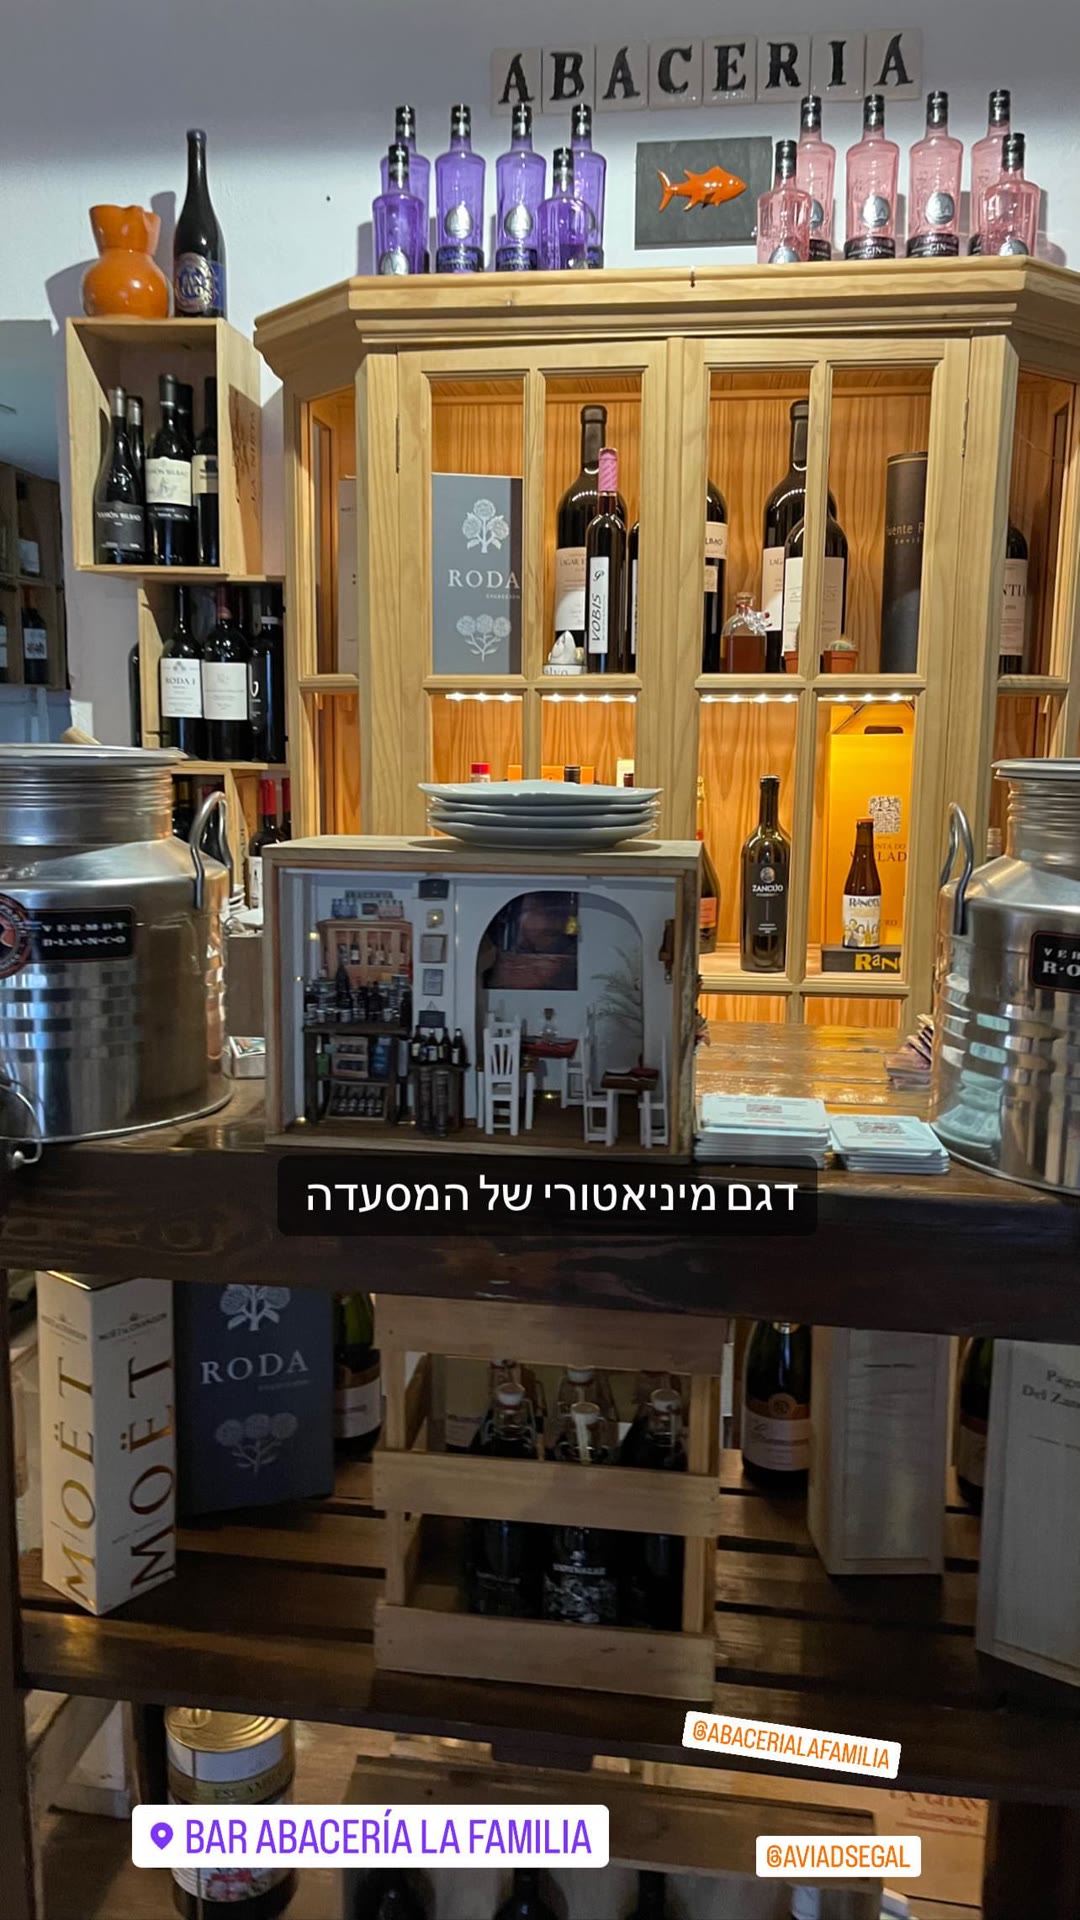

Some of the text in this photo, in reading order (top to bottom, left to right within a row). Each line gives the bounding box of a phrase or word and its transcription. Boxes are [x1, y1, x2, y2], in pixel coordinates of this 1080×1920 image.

[497, 31, 915, 105] ABACERIA
[929, 243, 947, 251] GIN
[447, 568, 521, 589] RODA
[591, 593, 602, 642] VOBIS
[854, 952, 902, 971] RaN
[199, 1348, 310, 1385] RODA
[54, 1355, 96, 1608] MOËT
[120, 1354, 176, 1594] MOËT
